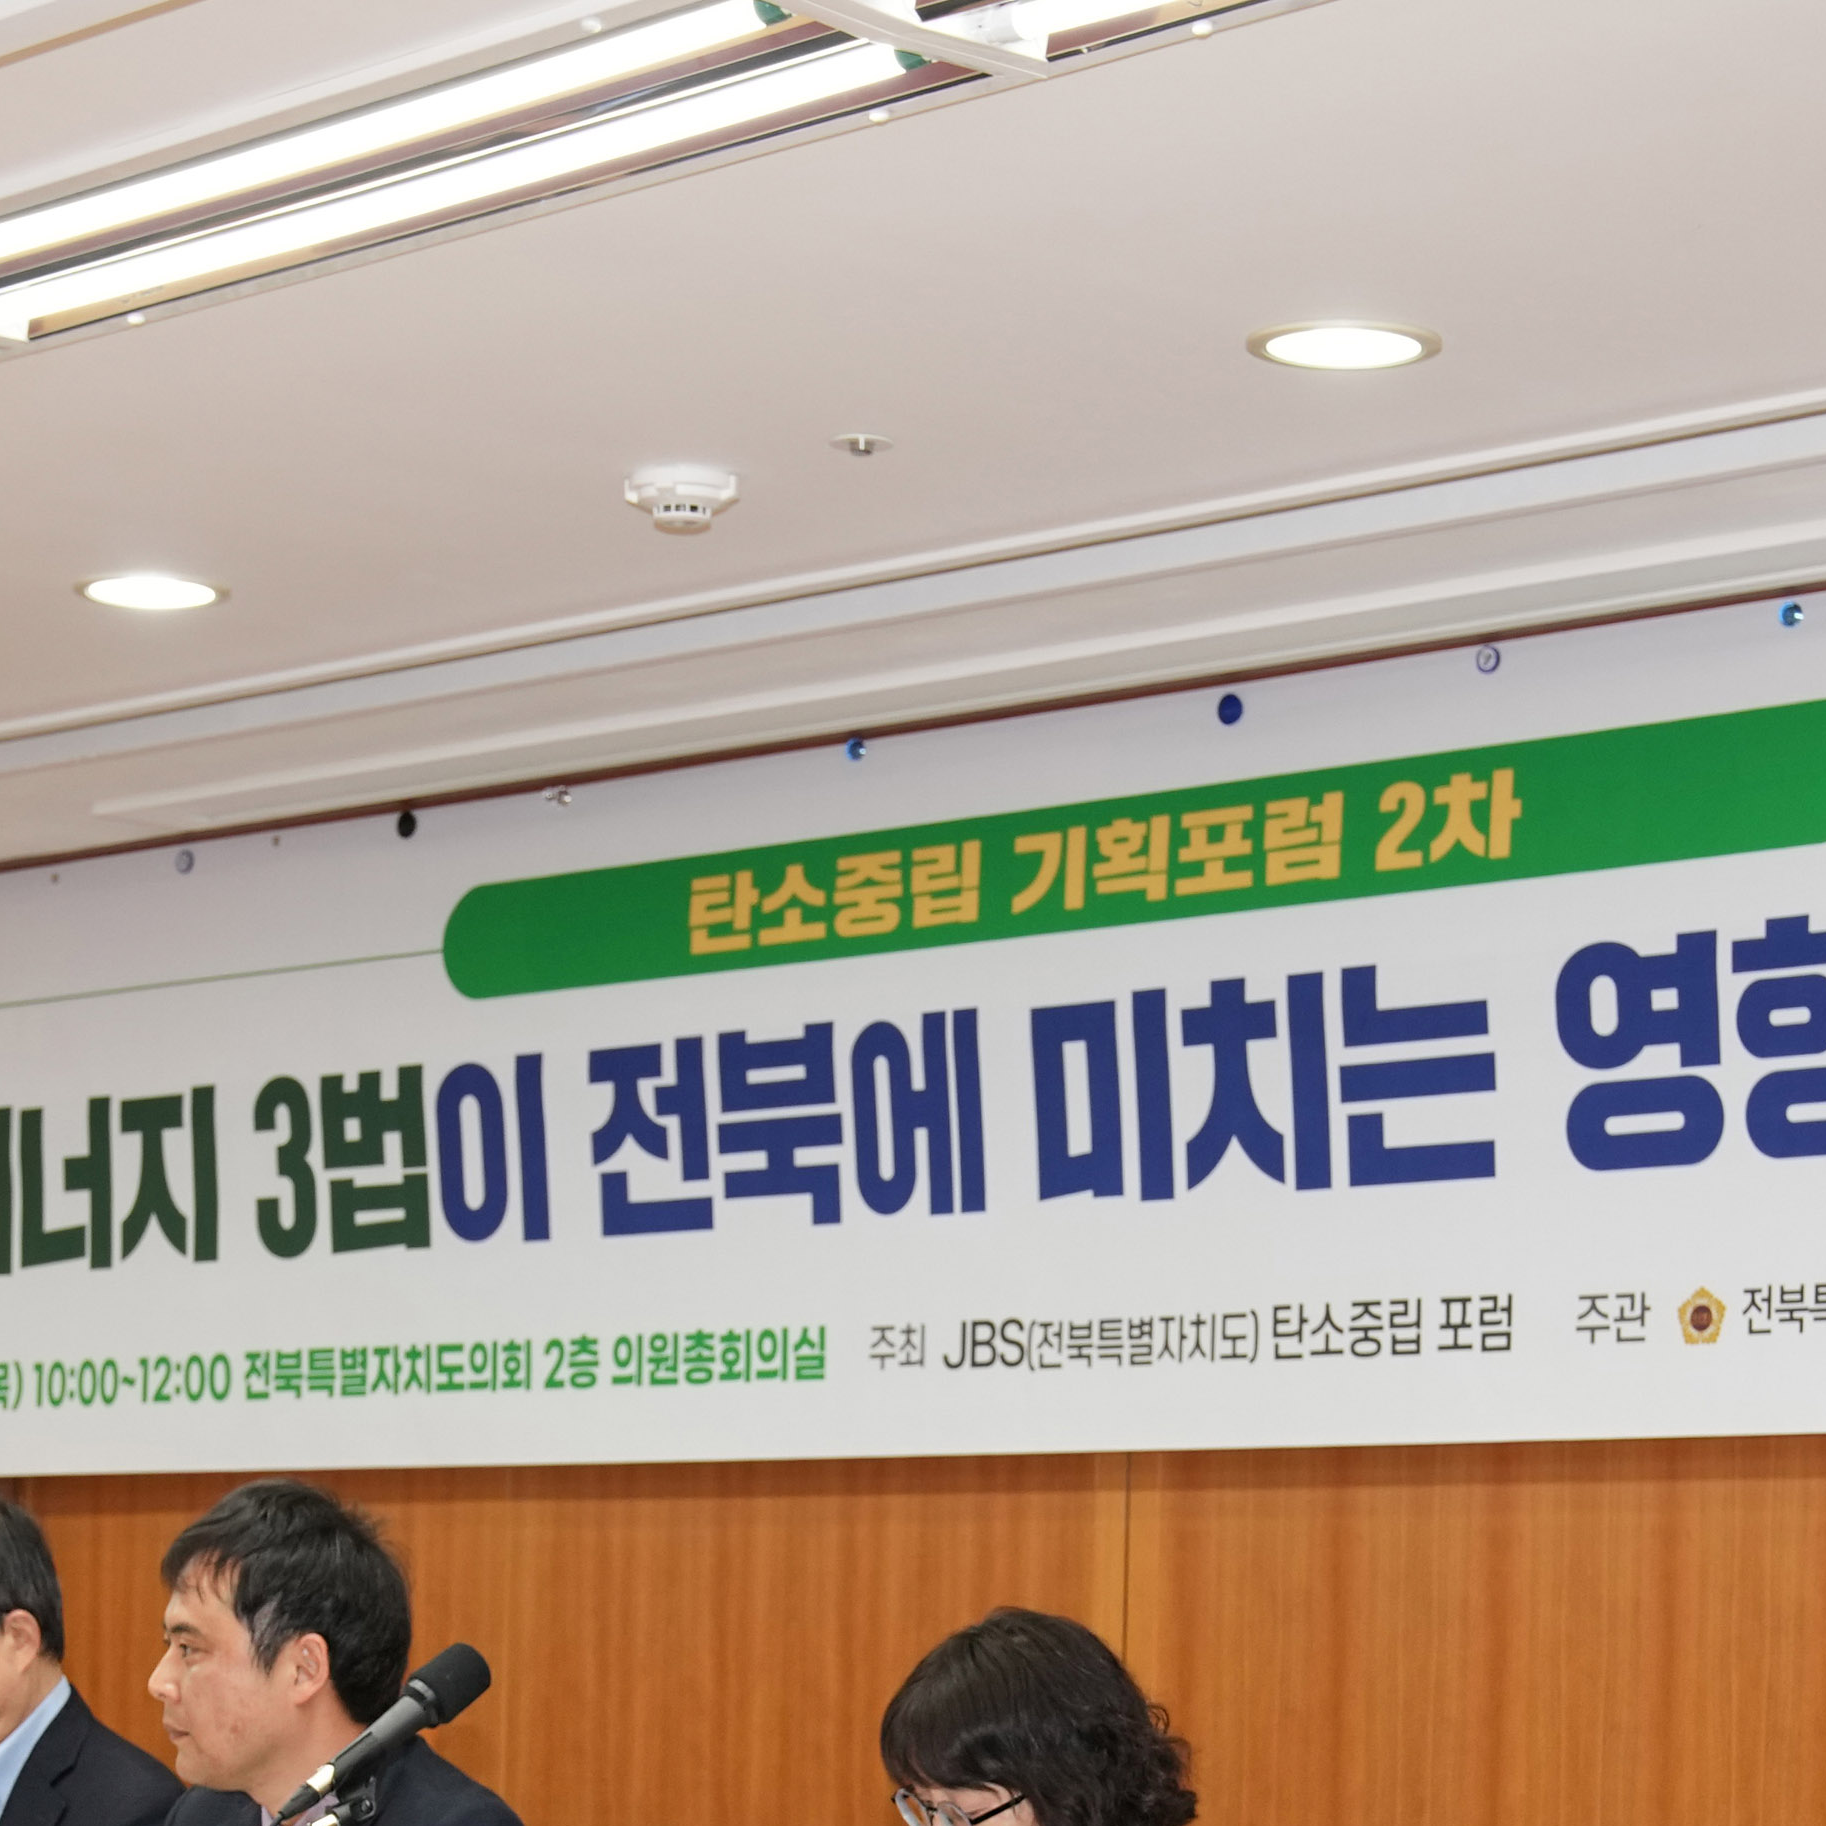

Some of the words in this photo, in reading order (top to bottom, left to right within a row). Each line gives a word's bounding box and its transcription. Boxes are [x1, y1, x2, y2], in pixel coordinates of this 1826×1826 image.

[691, 841, 979, 953] 탄소중립
[1013, 792, 1342, 912] 기획포럼
[1376, 770, 1521, 870] 2차
[255, 1054, 549, 1258] 3법이
[590, 1009, 985, 1235] 전북에
[1031, 966, 1495, 1200] 미치는
[870, 1325, 925, 1369] 주최
[943, 1309, 1258, 1371] JBS(전북특별자치도)
[1273, 1298, 1421, 1360] 탄소중립
[1438, 1293, 1512, 1352] 포럼
[1576, 1292, 1651, 1344] 주관
[34, 1353, 231, 1407] 10:00~12:00
[245, 1340, 531, 1400] 전북특별자치도의회
[544, 1335, 599, 1389] 2층
[612, 1326, 825, 1386] 의원총회의실
